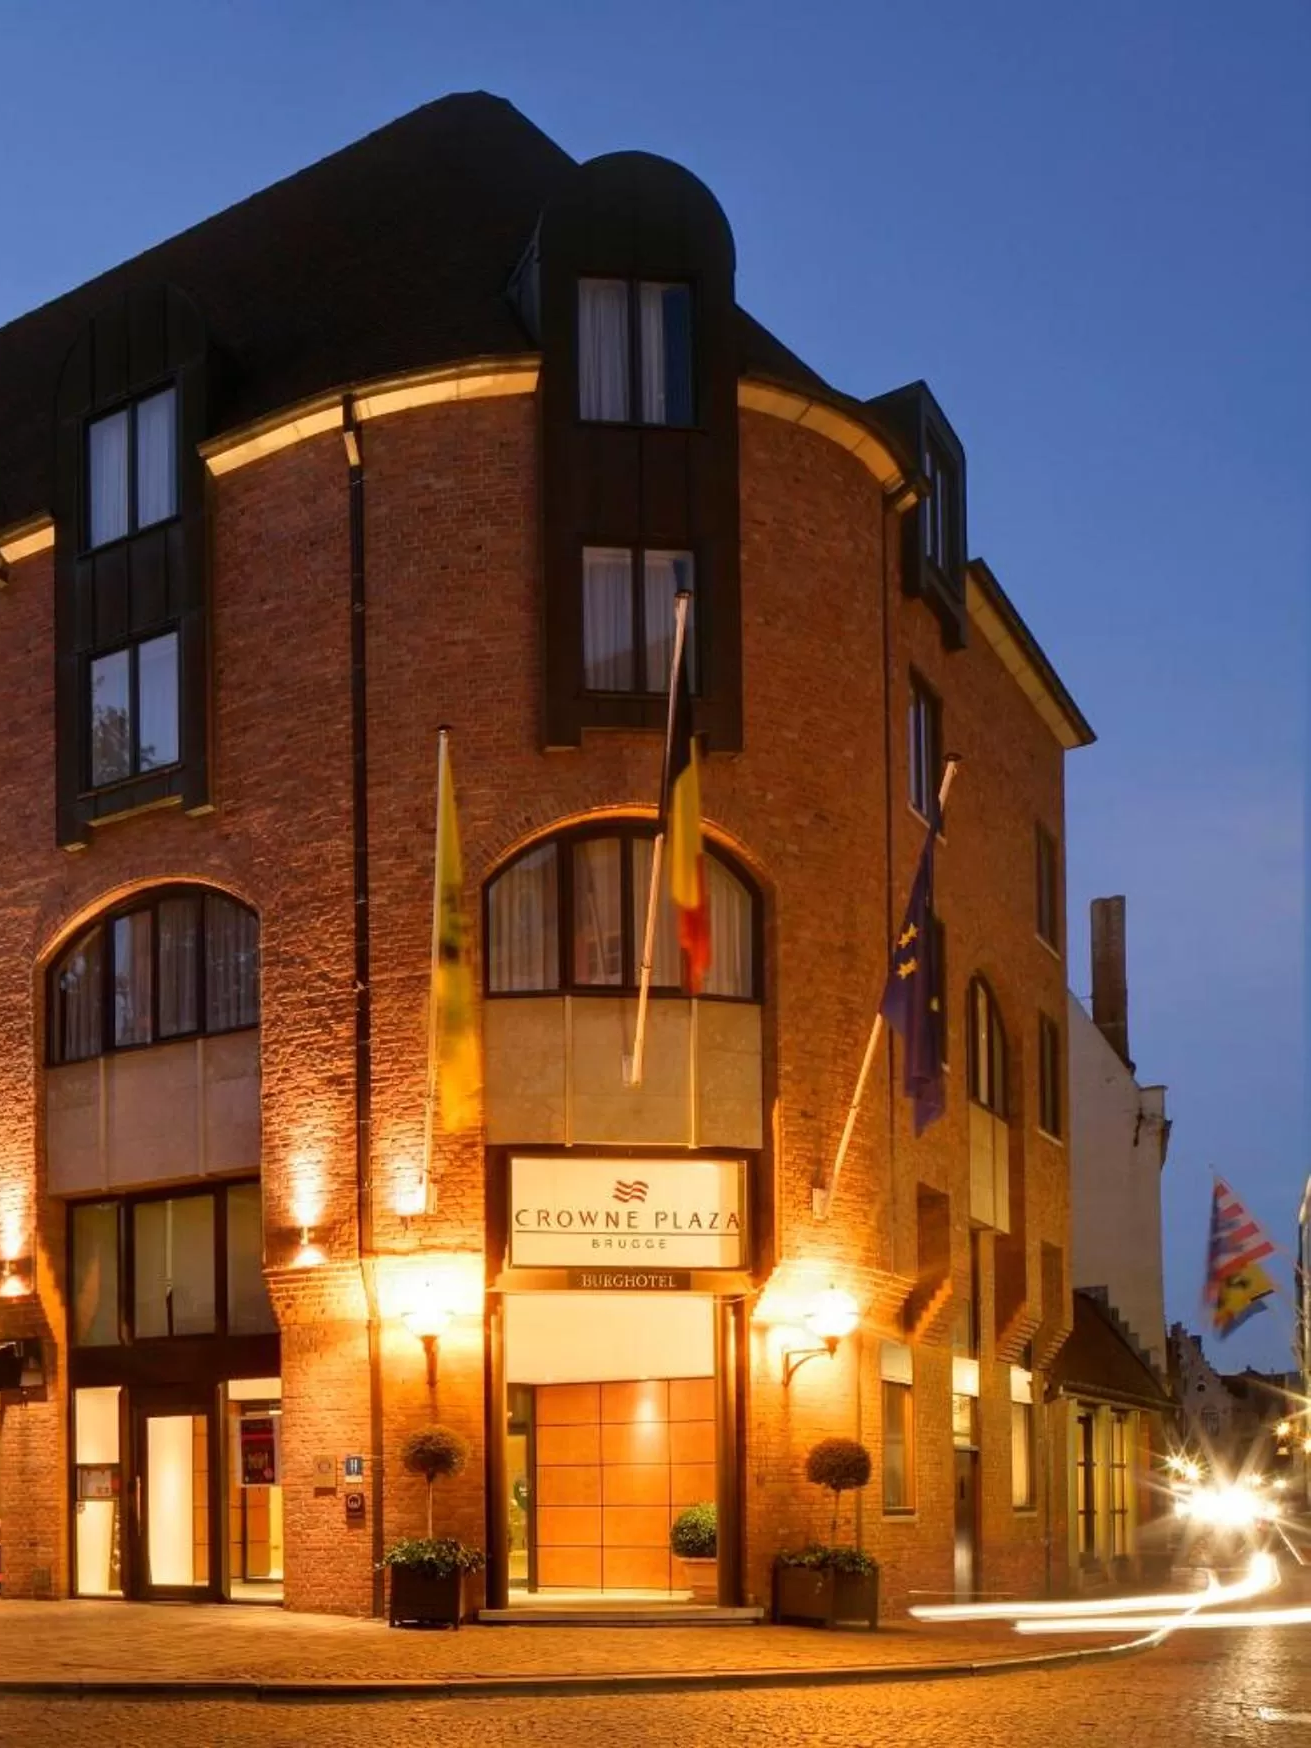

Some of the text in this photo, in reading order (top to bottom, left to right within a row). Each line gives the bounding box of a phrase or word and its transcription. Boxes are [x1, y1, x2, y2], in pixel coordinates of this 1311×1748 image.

[515, 1209, 740, 1230] CROWNE PLAZA
[592, 1239, 667, 1249] BRUGGE
[581, 1274, 677, 1289] BURGHOTEL
